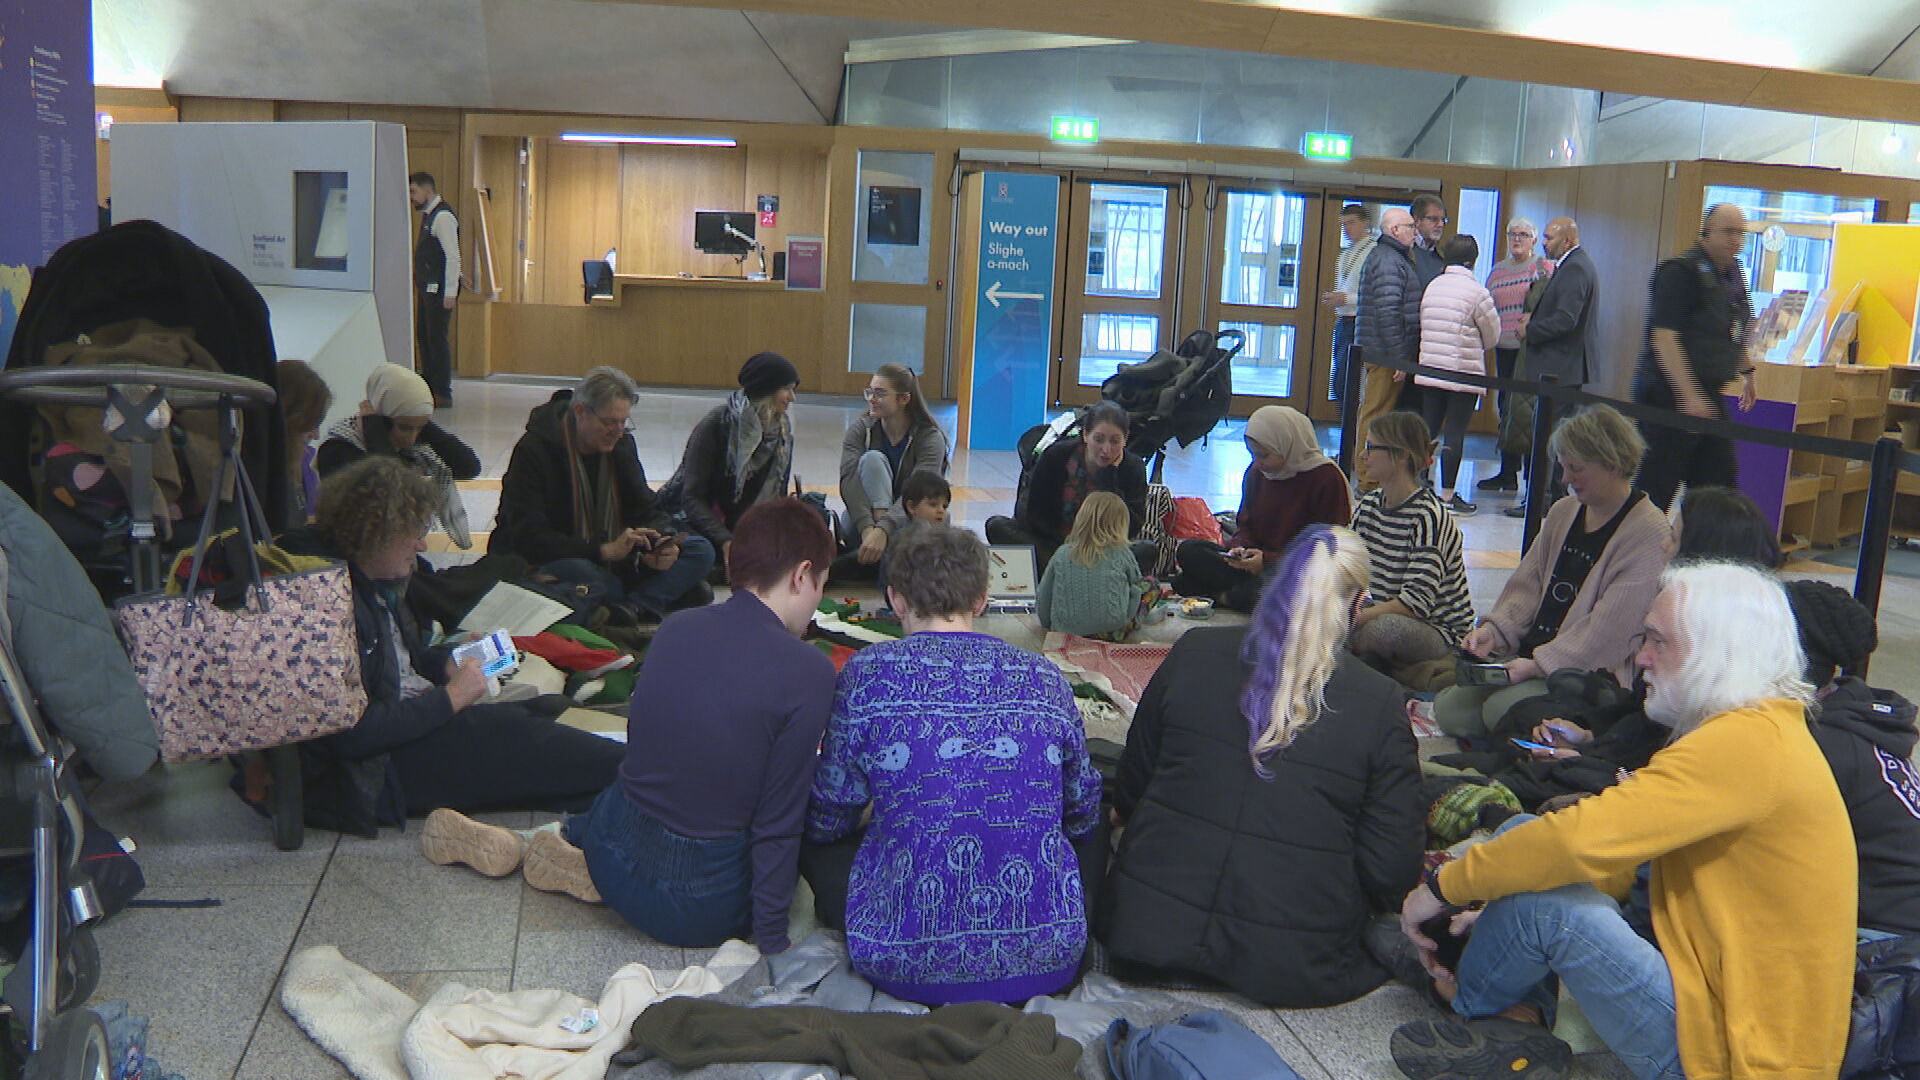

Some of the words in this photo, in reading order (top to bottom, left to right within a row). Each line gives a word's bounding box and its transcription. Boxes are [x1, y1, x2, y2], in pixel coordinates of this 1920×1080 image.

[989, 221, 1021, 238] Way
[1025, 226, 1048, 237] out
[988, 242, 1024, 258] Slighe
[987, 257, 1029, 271] a-mach
